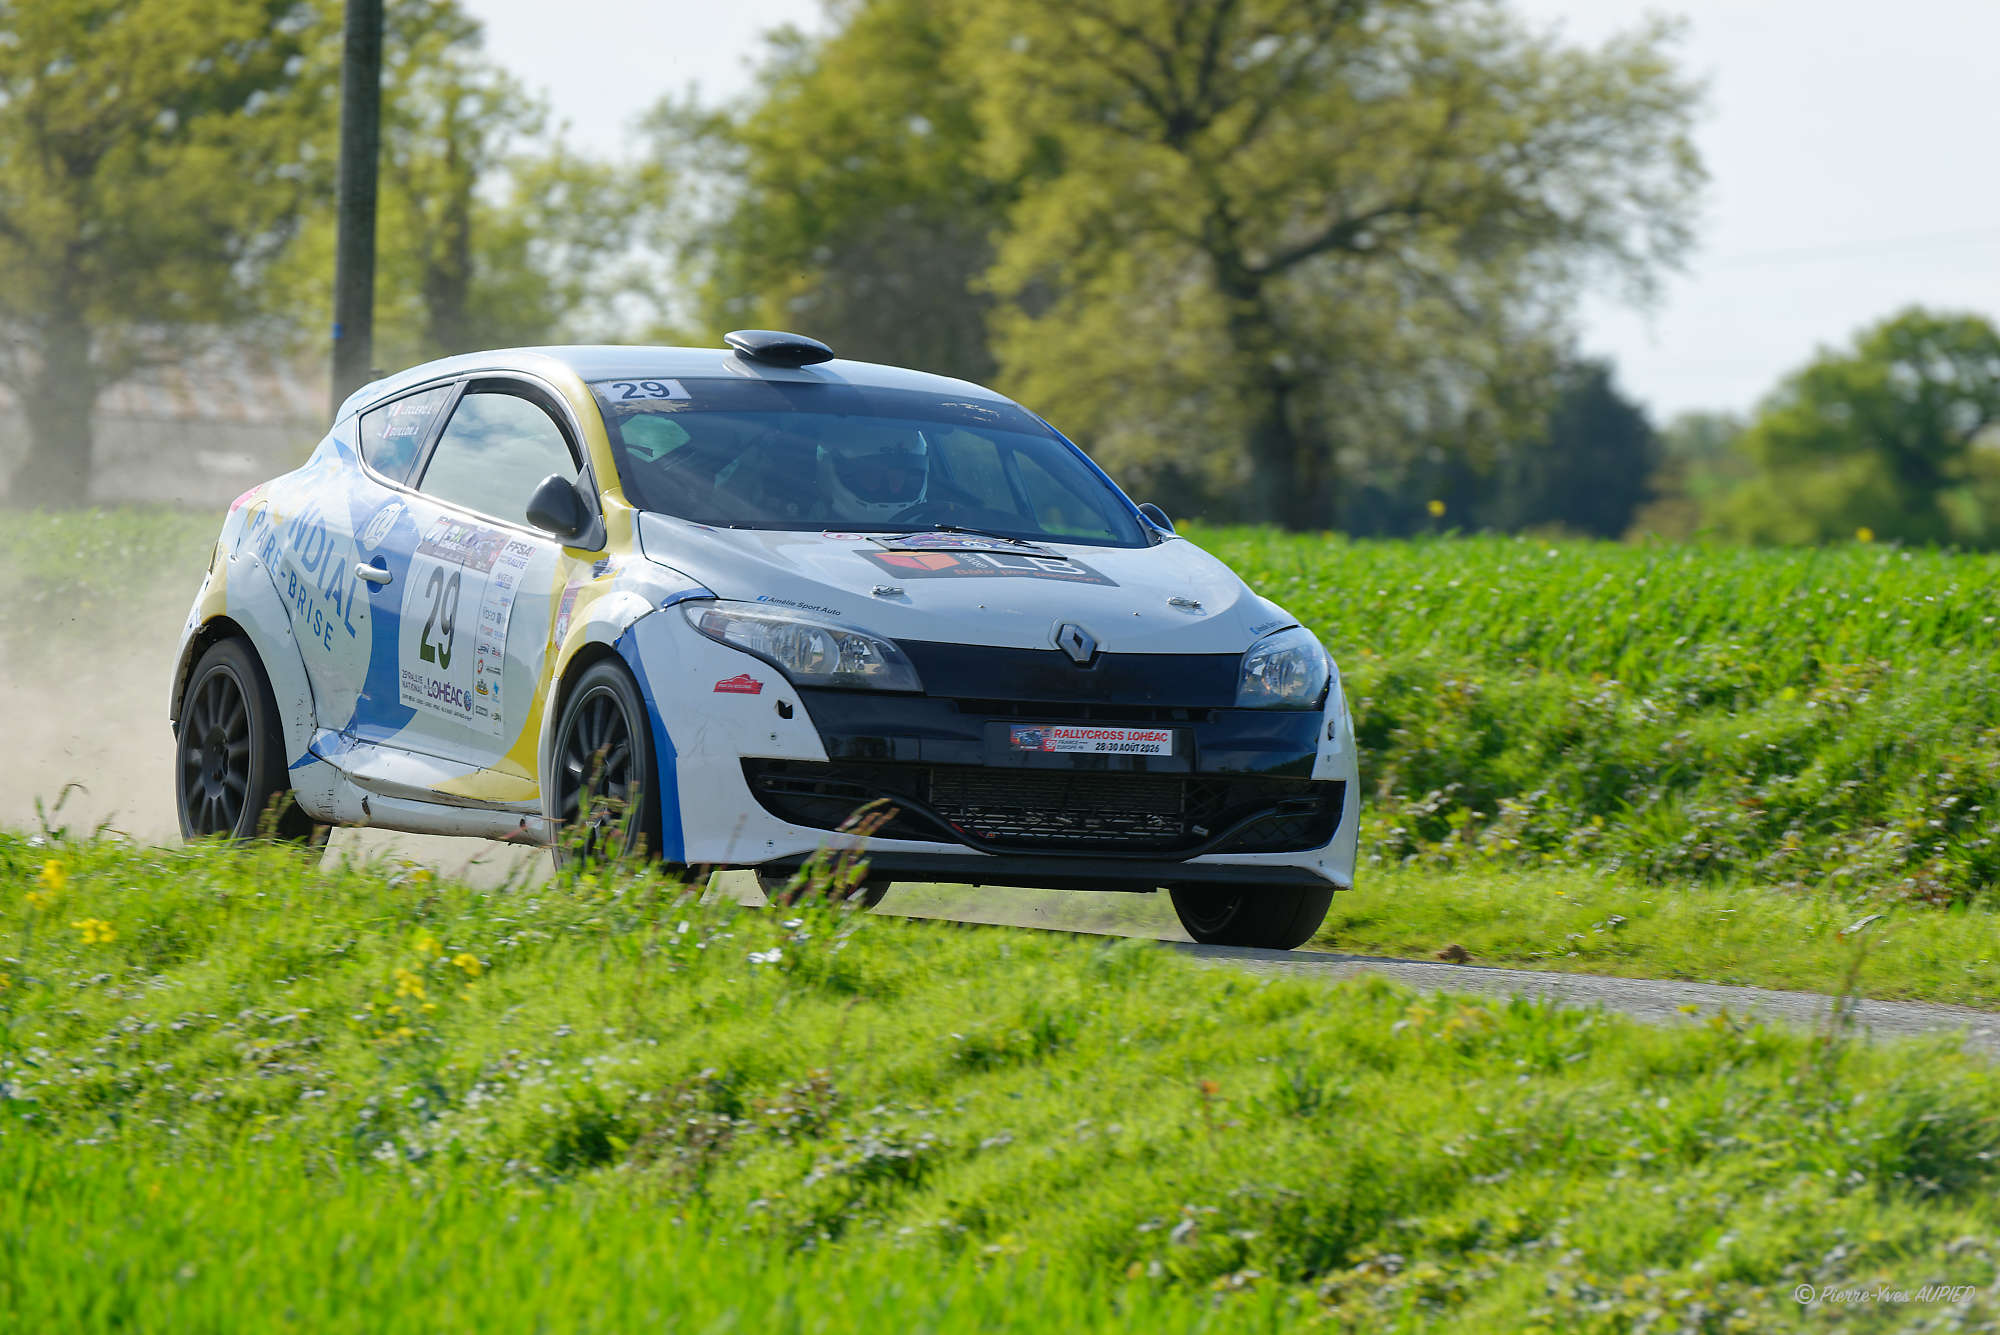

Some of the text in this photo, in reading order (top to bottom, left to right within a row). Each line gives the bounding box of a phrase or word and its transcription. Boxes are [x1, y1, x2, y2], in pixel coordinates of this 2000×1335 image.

[612, 381, 670, 400] 29
[505, 540, 533, 557] FFSA
[418, 564, 461, 671] 29
[797, 602, 821, 612] Sport
[821, 607, 841, 616] Auto
[427, 677, 463, 708] LOHÉAC
[1054, 728, 1168, 742] RALLYCROSS LOHÉAC
